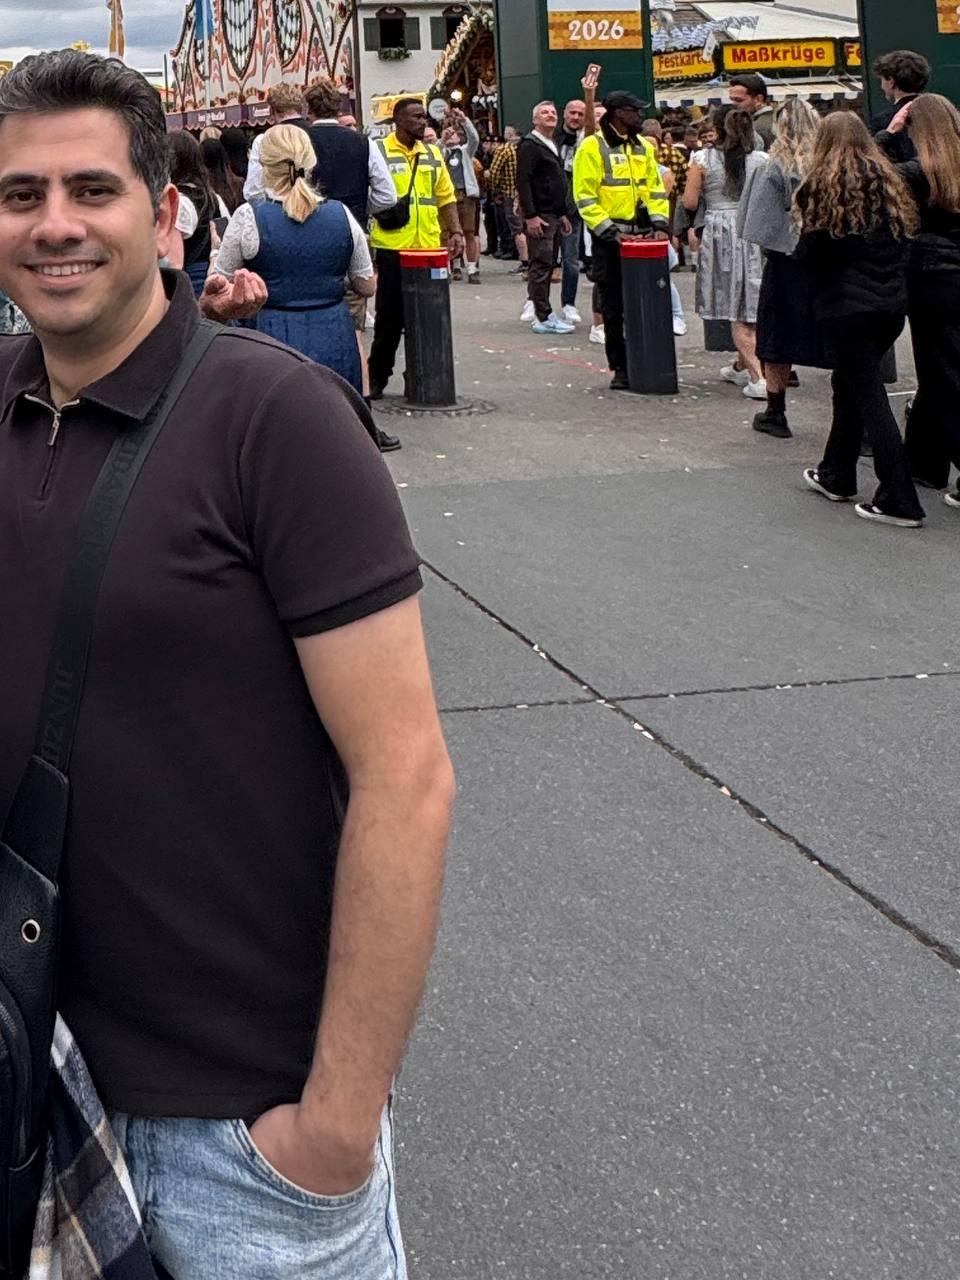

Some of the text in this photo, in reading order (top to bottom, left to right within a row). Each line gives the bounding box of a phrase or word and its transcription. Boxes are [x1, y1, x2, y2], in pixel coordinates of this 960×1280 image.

[568, 20, 625, 41] 2026
[659, 51, 711, 68] Festkart
[731, 45, 826, 63] Maßkrüge
